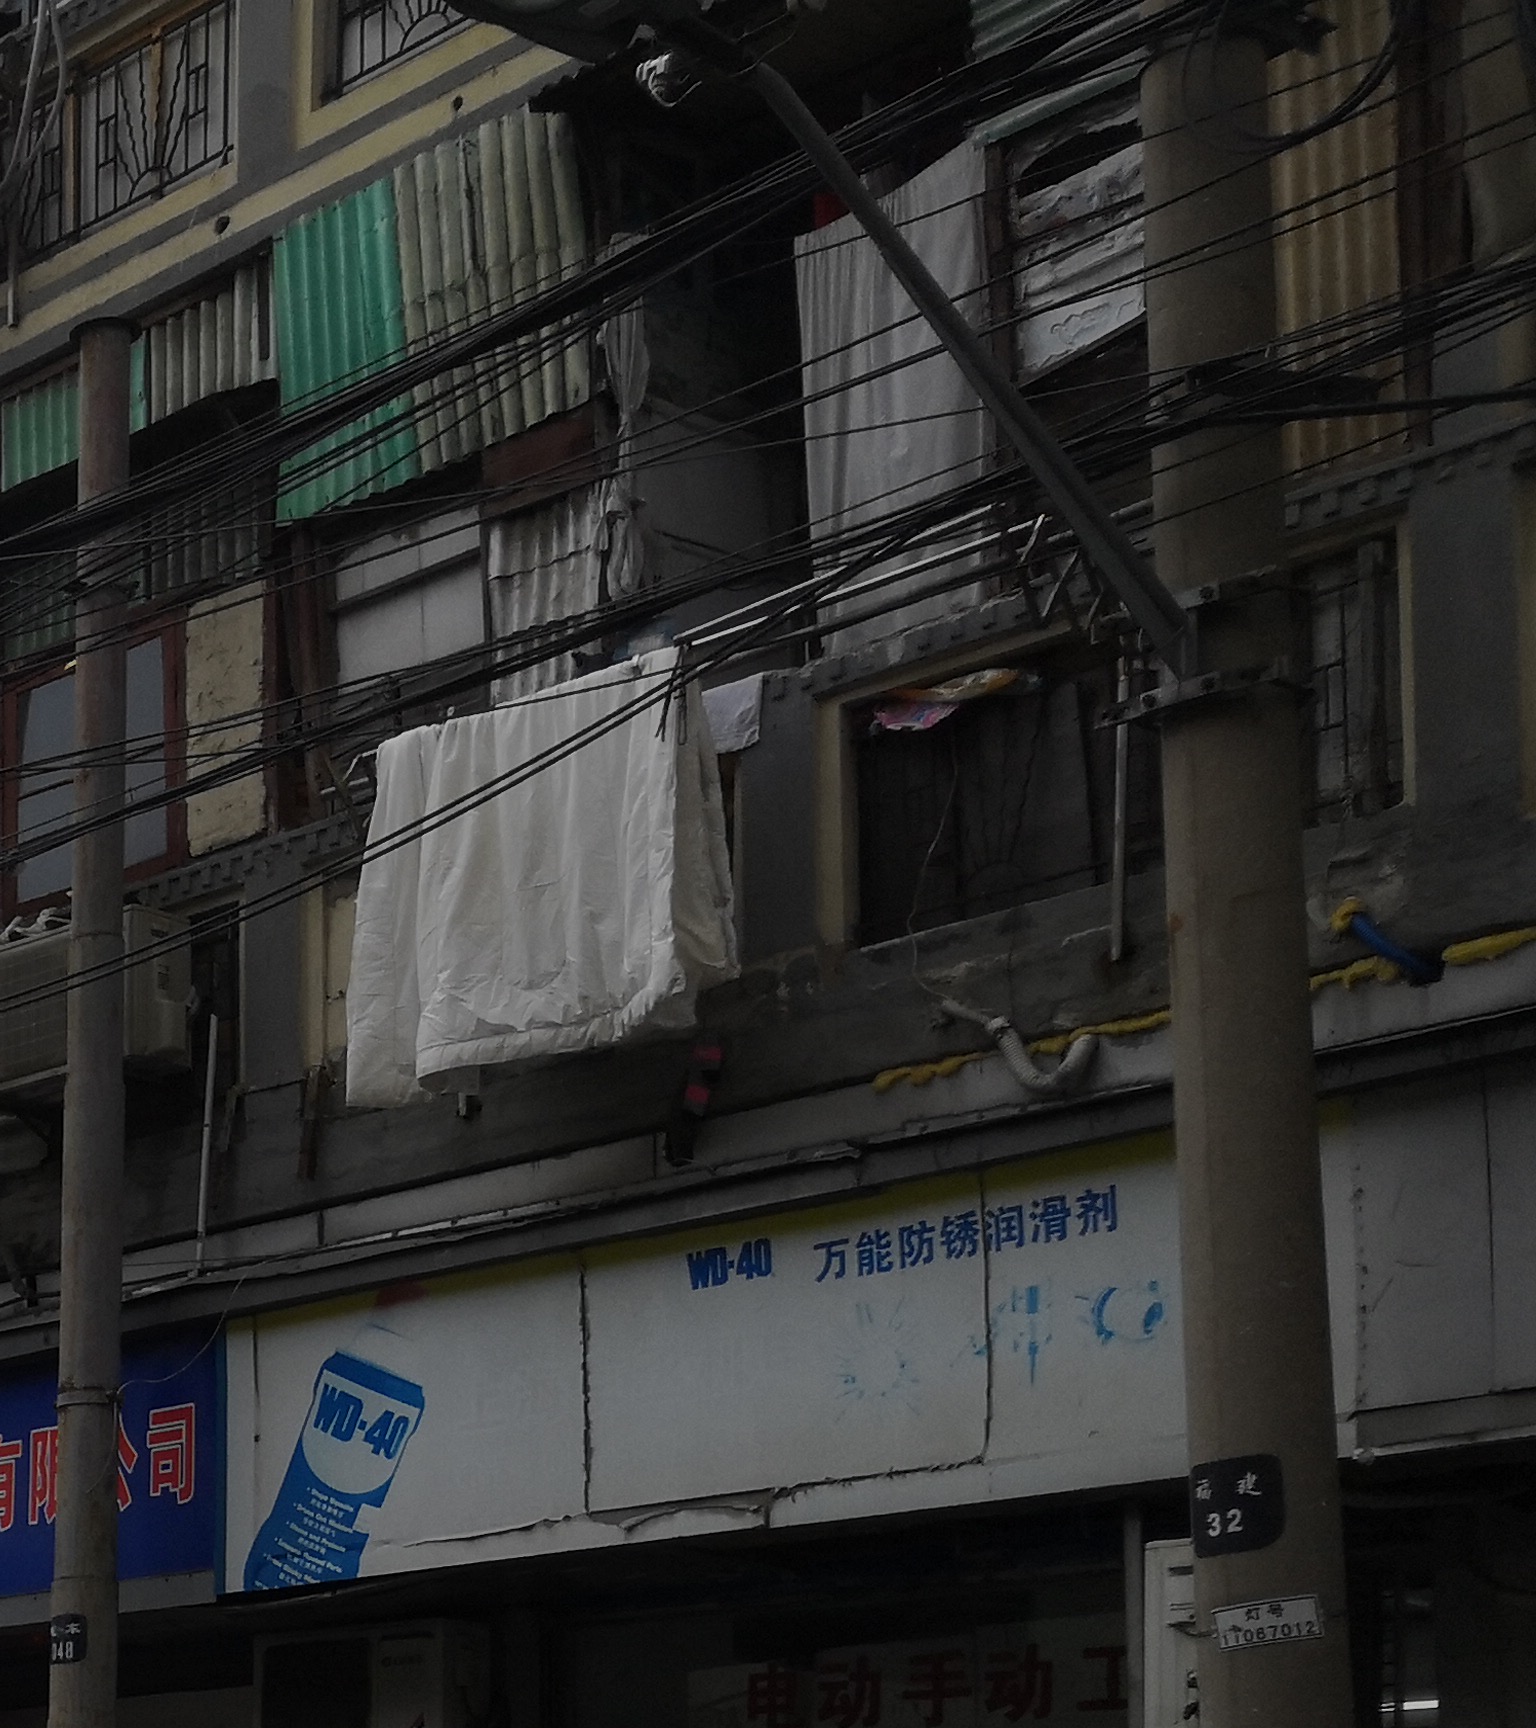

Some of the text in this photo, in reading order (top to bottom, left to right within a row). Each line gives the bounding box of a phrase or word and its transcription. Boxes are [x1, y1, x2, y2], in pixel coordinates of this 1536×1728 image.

[686, 1184, 1118, 1291] WD-40 万能防锈润滑剂
[314, 1383, 410, 1461] WD-40
[1206, 1506, 1245, 1538] 32
